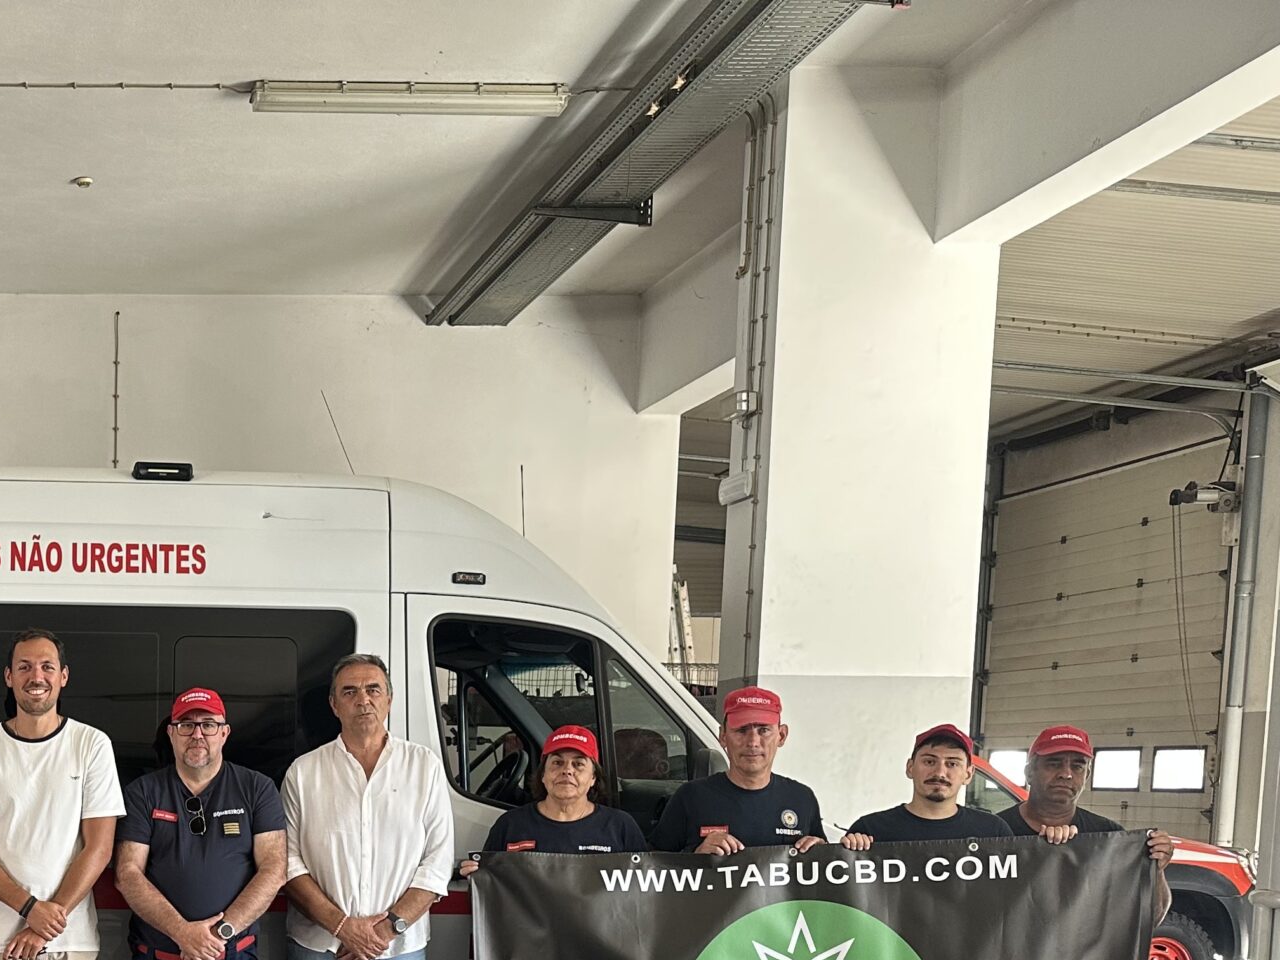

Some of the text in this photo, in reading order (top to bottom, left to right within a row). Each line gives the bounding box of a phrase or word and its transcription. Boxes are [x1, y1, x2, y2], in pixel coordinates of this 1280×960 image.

[10, 534, 63, 572] NÃO
[72, 542, 207, 575] URGENTES
[600, 854, 1019, 893] WWW.TABUCBD.COM
